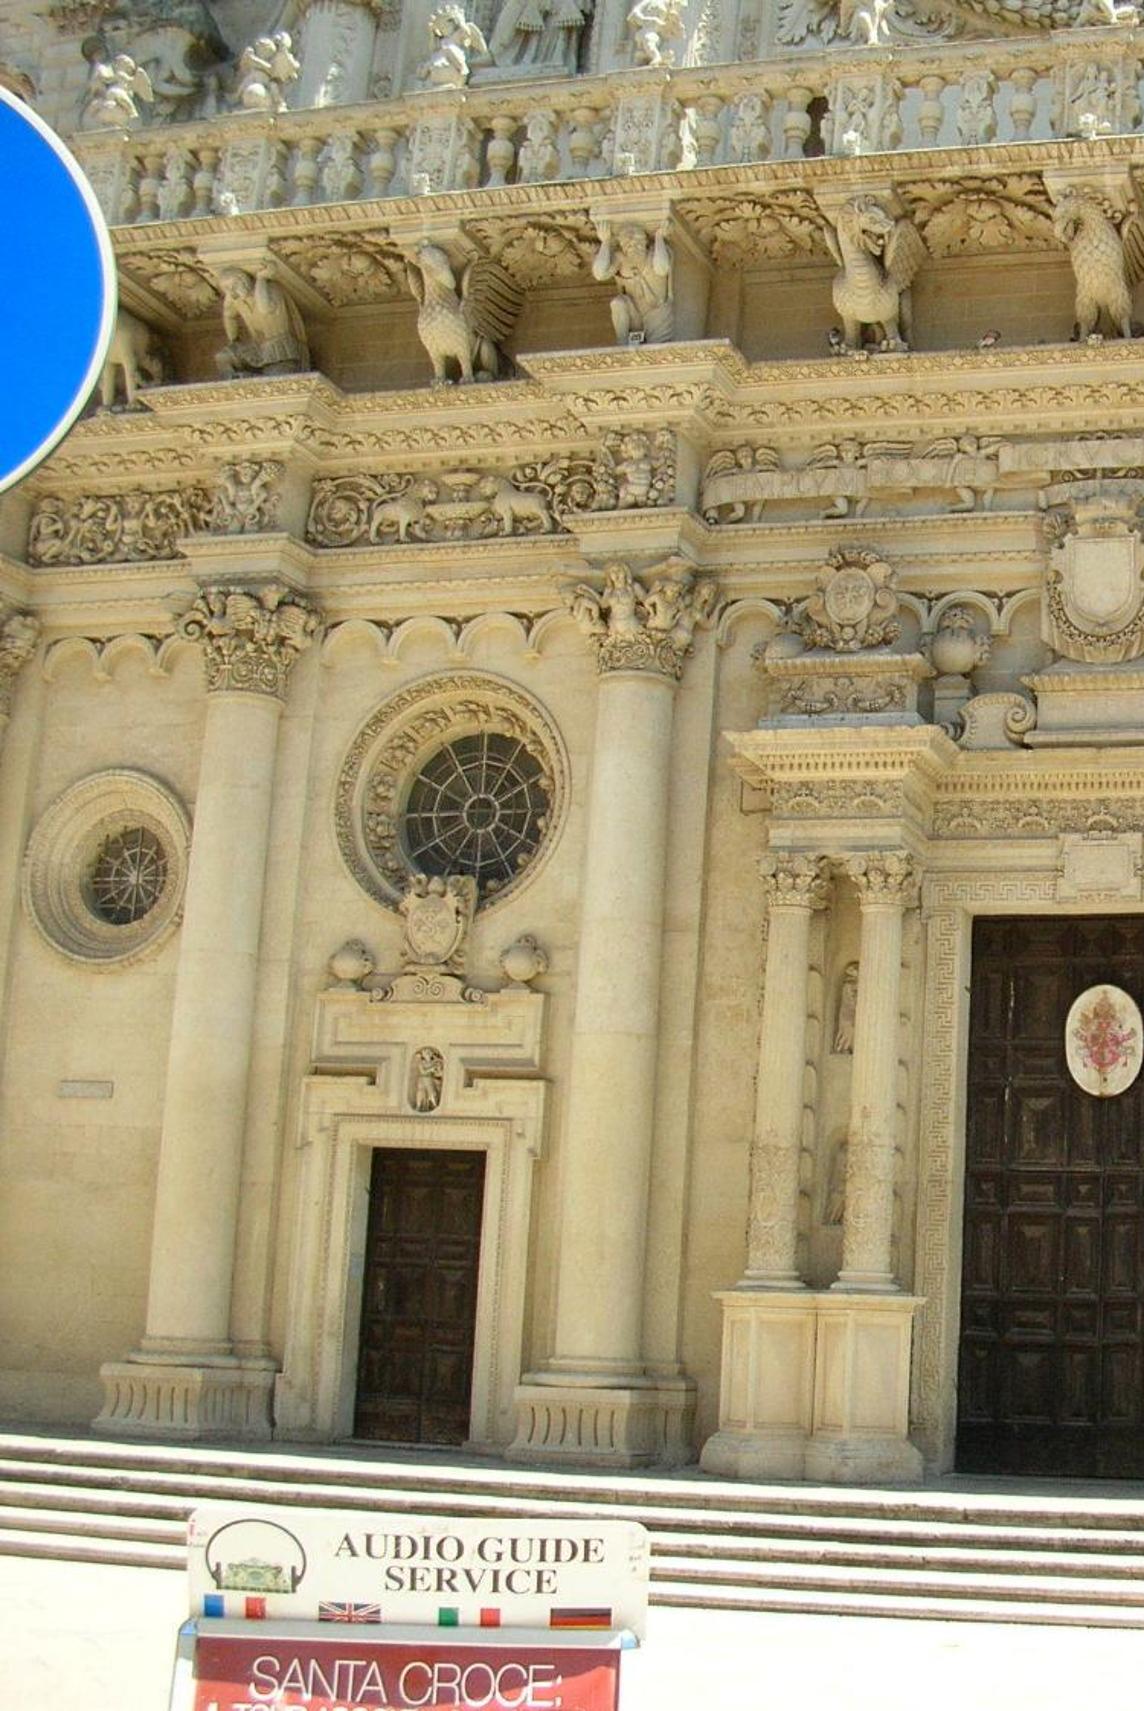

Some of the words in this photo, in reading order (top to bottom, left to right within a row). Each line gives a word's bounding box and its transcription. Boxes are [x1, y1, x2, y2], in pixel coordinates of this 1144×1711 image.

[334, 1532, 466, 1563] AUDIO
[477, 1537, 606, 1564] GUIDE
[384, 1566, 560, 1596] SERVICE
[248, 1655, 389, 1703] SANTA
